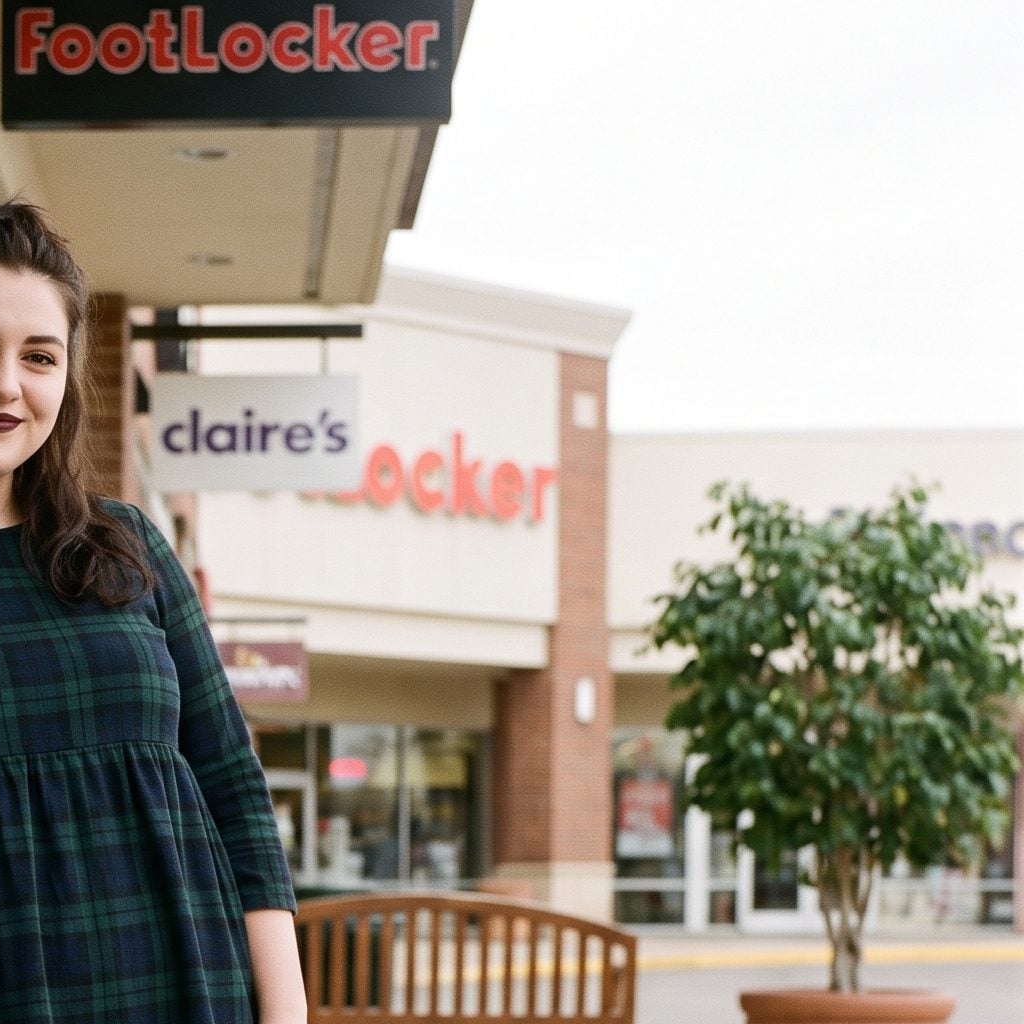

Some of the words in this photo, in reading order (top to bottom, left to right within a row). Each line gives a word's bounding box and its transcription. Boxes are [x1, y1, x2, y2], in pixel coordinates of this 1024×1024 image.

[15, 4, 440, 75] FootLocker
[162, 408, 347, 454] claire's
[300, 431, 558, 522] ocker
